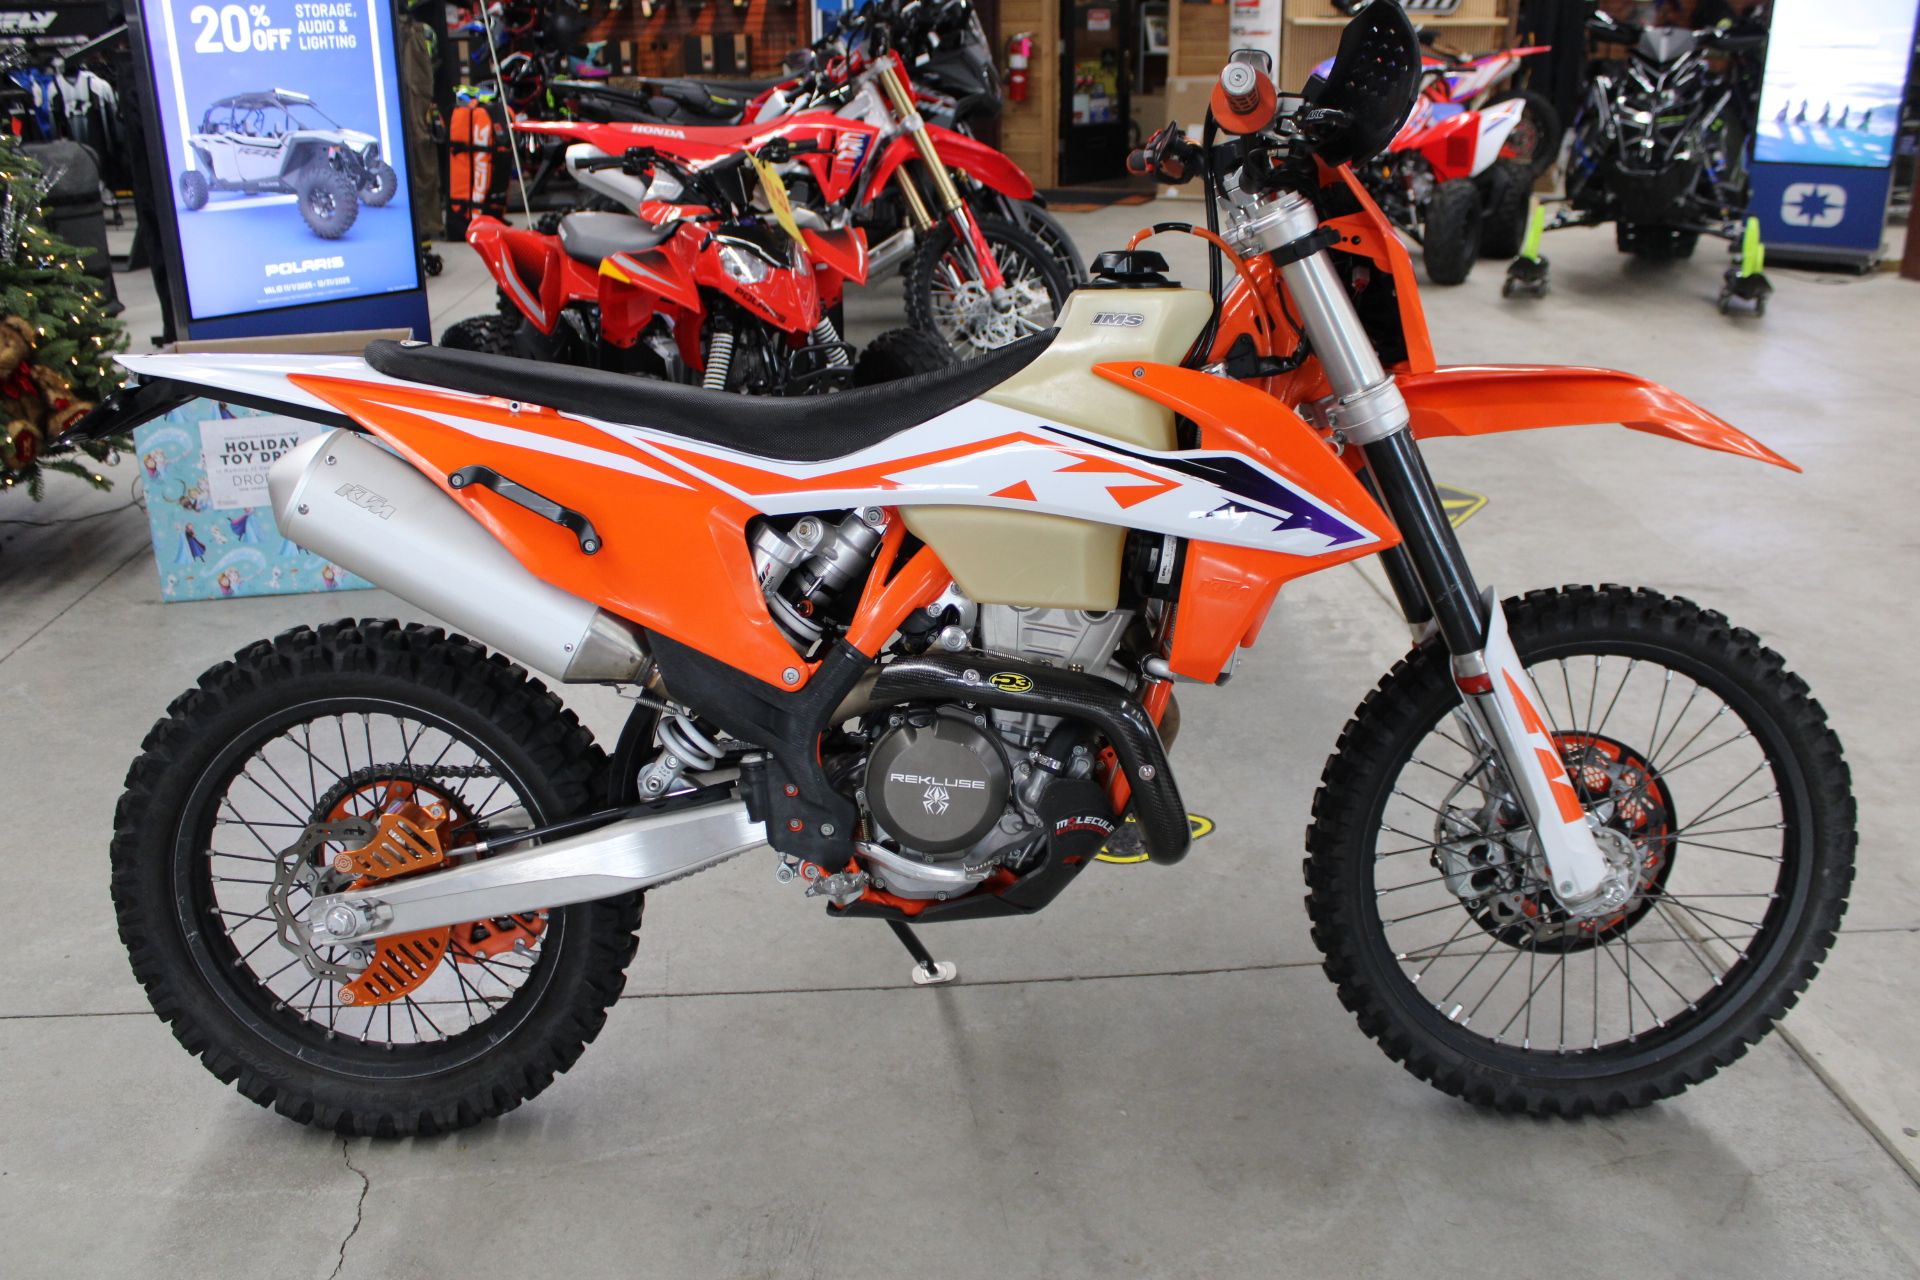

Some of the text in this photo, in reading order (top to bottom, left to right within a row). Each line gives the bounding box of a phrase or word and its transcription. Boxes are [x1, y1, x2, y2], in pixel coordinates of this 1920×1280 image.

[295, 3, 357, 18] STORAGE,
[298, 19, 348, 34] AUDIO &
[252, 28, 292, 51] OFF
[299, 34, 357, 50] LIGHTING
[632, 124, 686, 140] HONDA
[265, 256, 345, 277] POLARIS
[1091, 312, 1144, 327] IMS
[225, 437, 300, 454] HOLIDAY
[220, 453, 253, 465] TOY
[334, 483, 397, 520] KTM
[890, 773, 986, 790] REKLUSE
